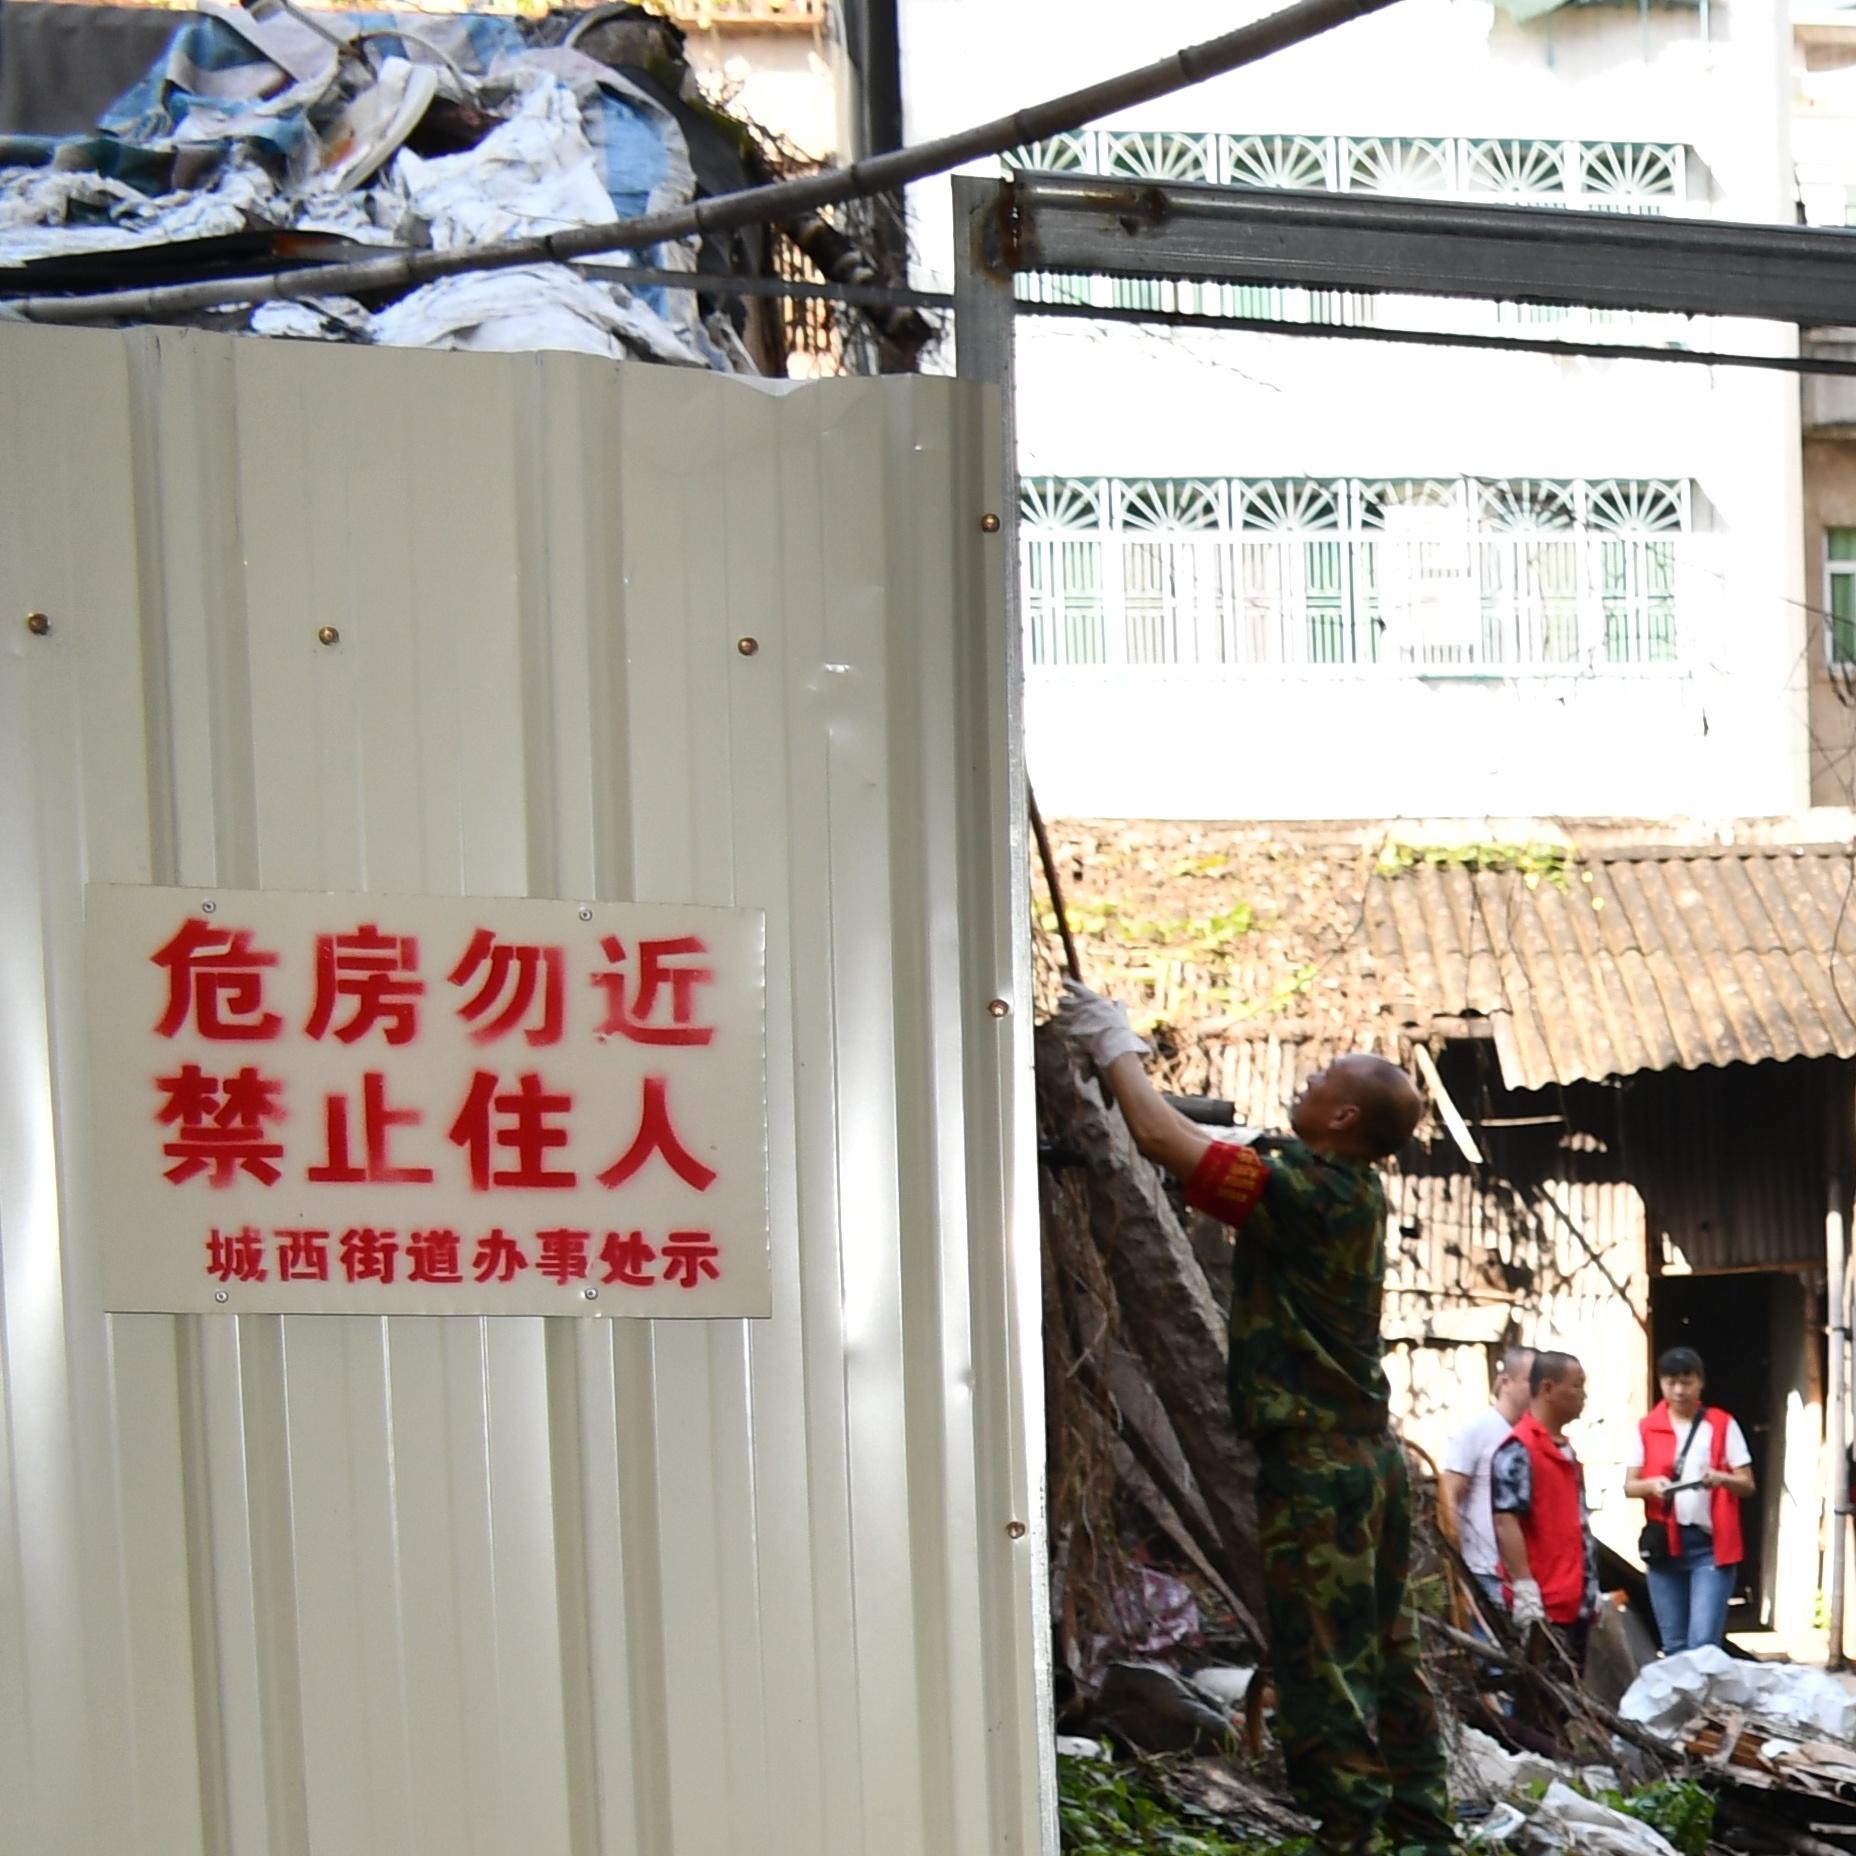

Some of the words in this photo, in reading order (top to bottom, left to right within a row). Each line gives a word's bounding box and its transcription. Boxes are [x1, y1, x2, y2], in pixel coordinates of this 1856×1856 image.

[151, 916, 717, 1048] 危房勿近
[155, 1064, 718, 1193] 禁止住人
[205, 1227, 721, 1289] 城西街道办事处示
